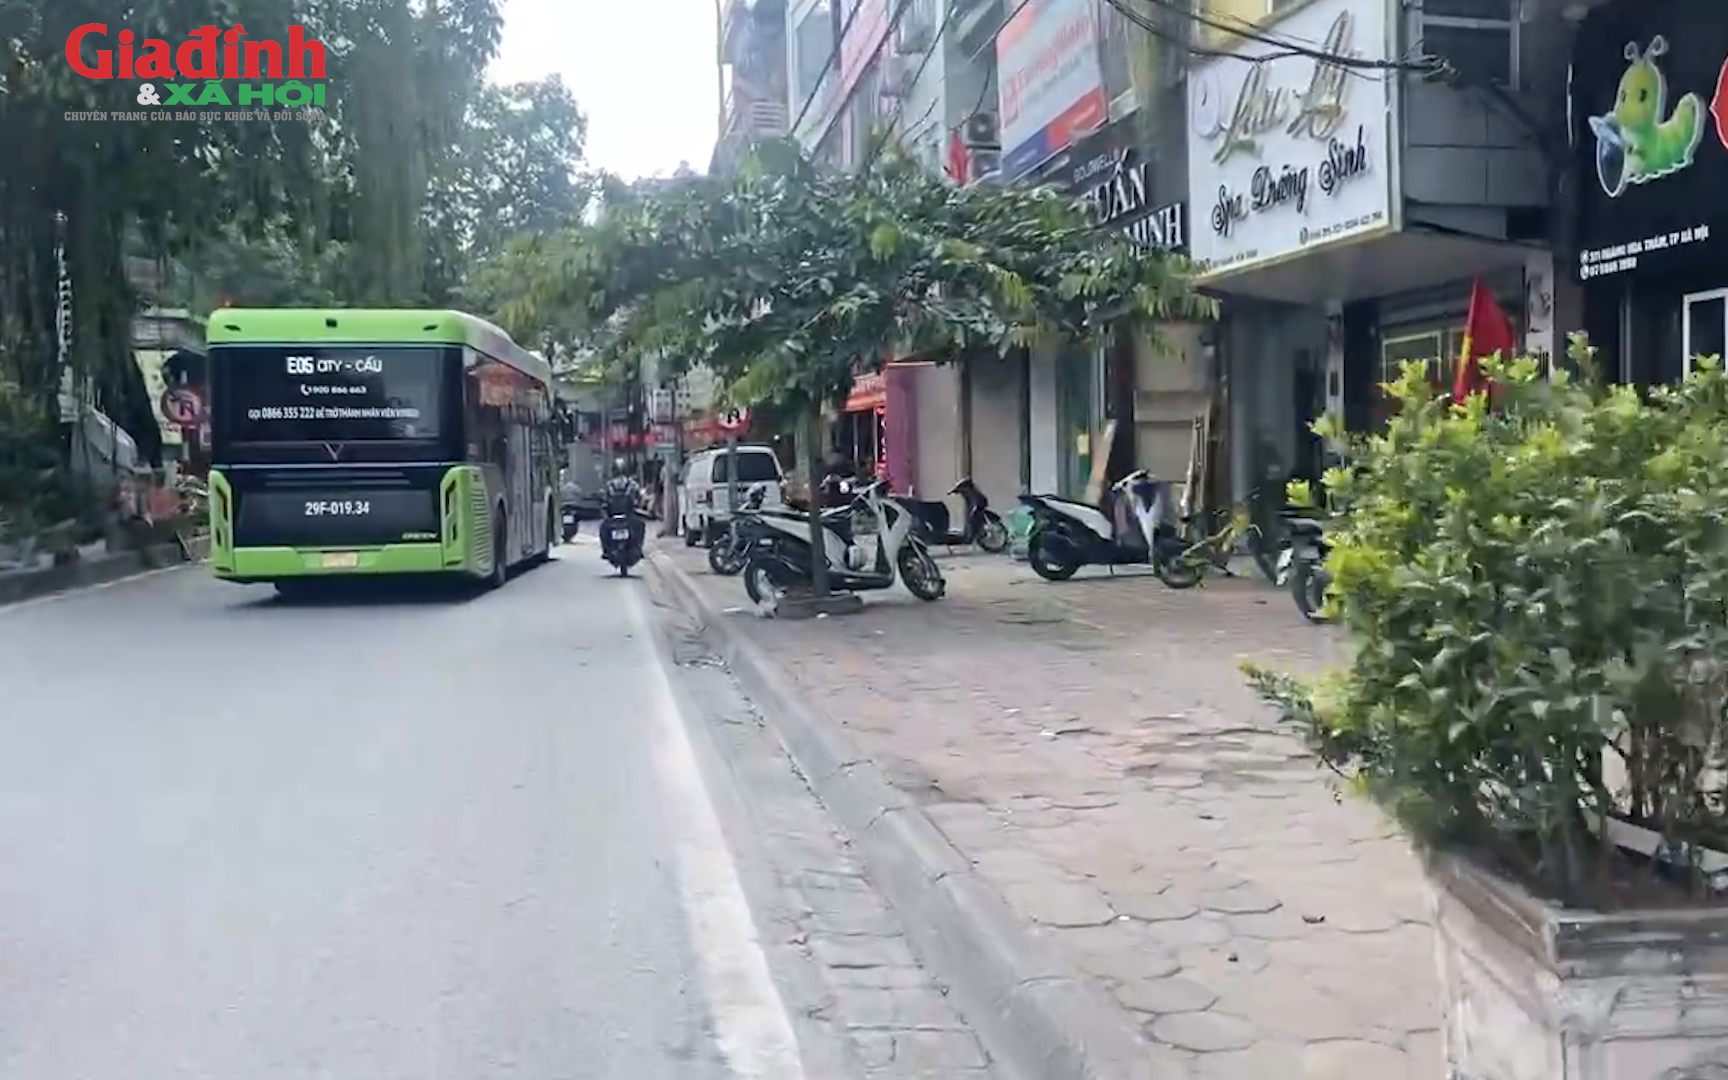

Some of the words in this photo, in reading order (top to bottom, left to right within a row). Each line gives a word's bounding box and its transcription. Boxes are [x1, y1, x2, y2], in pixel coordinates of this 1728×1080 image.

[1212, 184, 1249, 238] Spa
[1318, 125, 1367, 196] Sinh
[300, 407, 315, 419] 222
[305, 501, 370, 516] 29F-019.34
